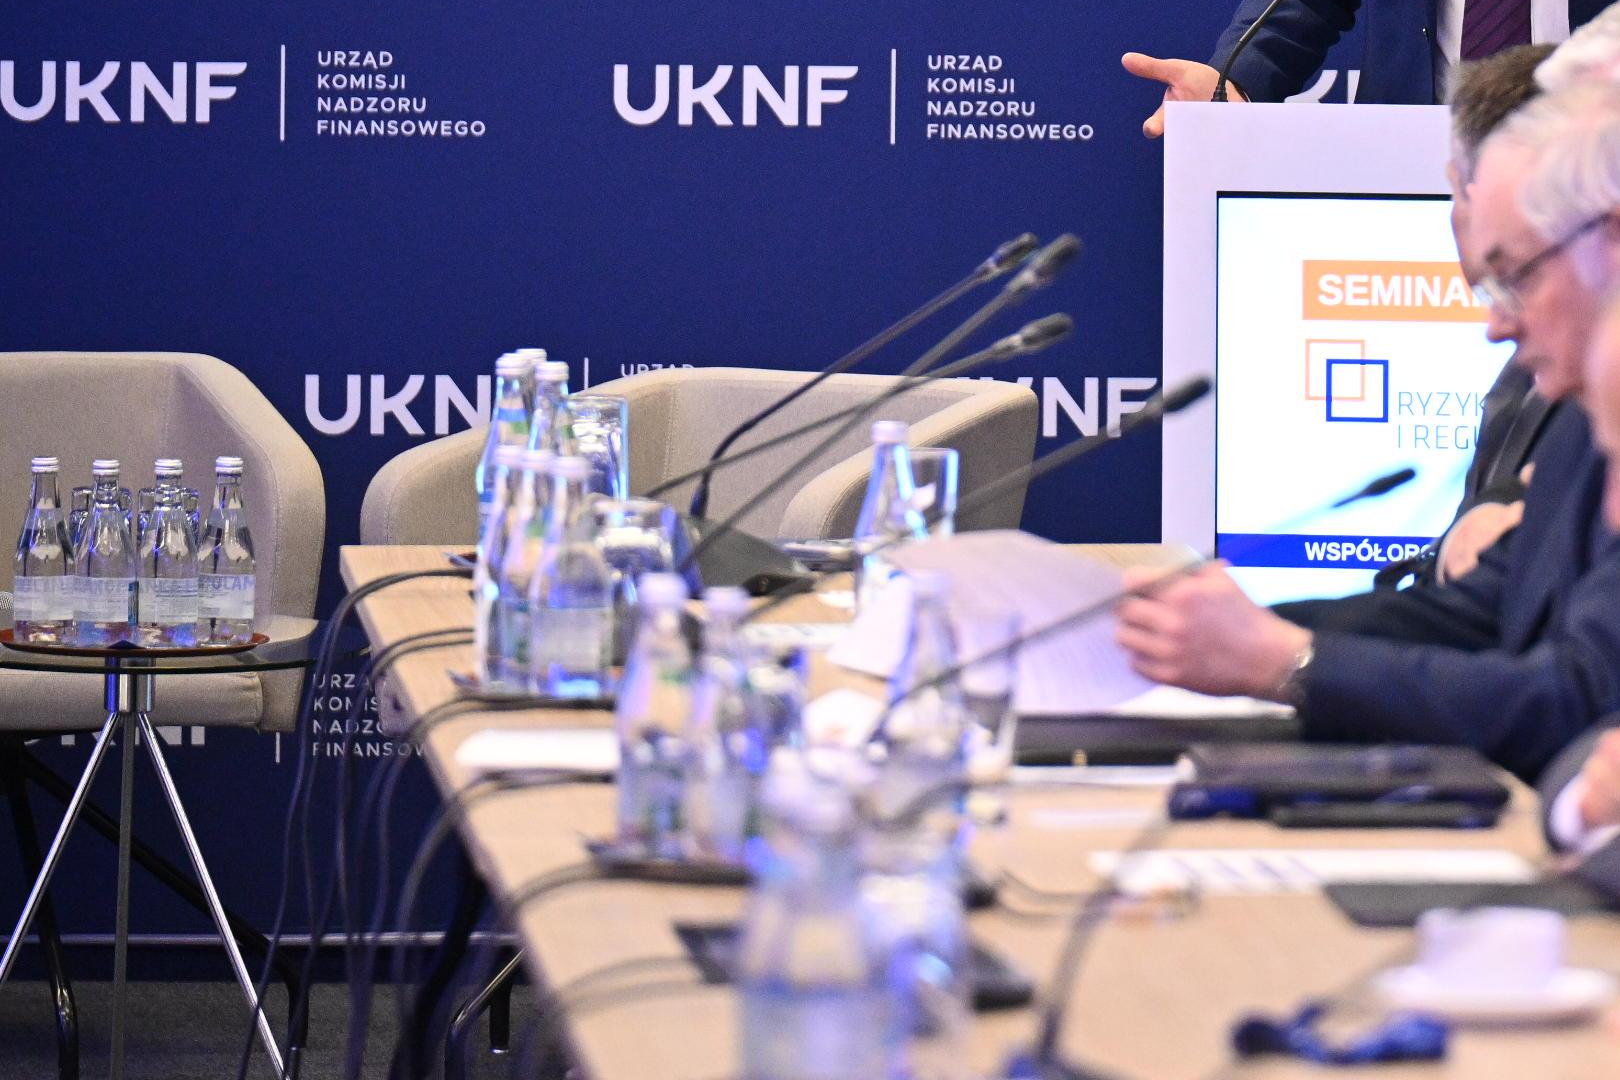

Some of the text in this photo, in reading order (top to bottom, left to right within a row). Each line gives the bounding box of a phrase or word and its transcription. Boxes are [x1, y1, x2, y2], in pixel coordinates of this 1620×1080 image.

[317, 50, 393, 69] URZĄD
[927, 54, 1003, 73] URZĄD
[0, 60, 248, 123] UKNF
[317, 73, 406, 90] KOMISJI
[927, 77, 1015, 94] KOMISJI
[317, 96, 427, 113] NADZORU
[613, 63, 859, 127] UKNF
[927, 100, 1035, 117] NADZORU
[317, 119, 486, 137] FINANSOWEGO
[926, 123, 1094, 140] FINANSOWEGO
[1317, 273, 1480, 308] SEMINA
[304, 373, 491, 436] UKN
[1017, 376, 1158, 438] NF
[1398, 391, 1487, 417] RYZYK
[1414, 424, 1478, 450] REG
[1304, 538, 1432, 563] WSPÓŁOR
